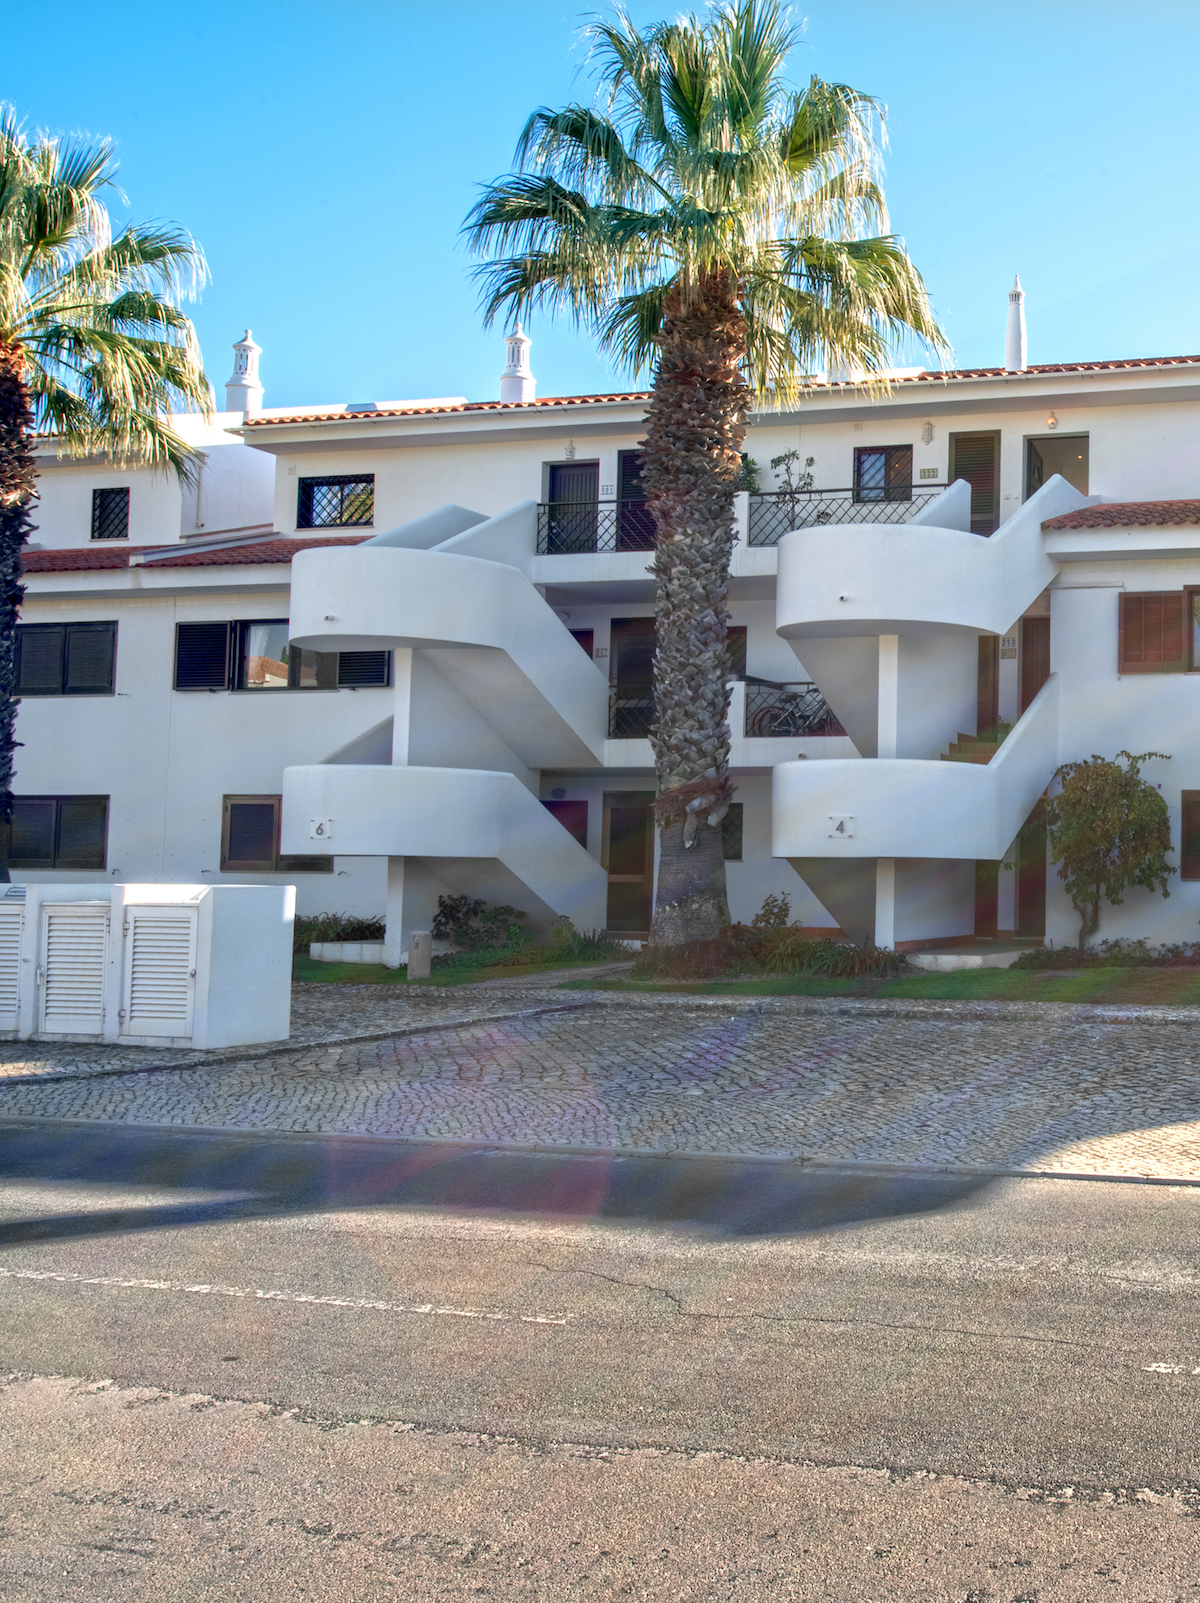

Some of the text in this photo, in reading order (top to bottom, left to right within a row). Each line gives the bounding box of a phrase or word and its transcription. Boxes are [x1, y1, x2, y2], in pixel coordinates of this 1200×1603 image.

[922, 469, 936, 477] 322
[1001, 638, 1016, 646] 313
[316, 822, 324, 835] 6
[836, 820, 844, 834] 4
